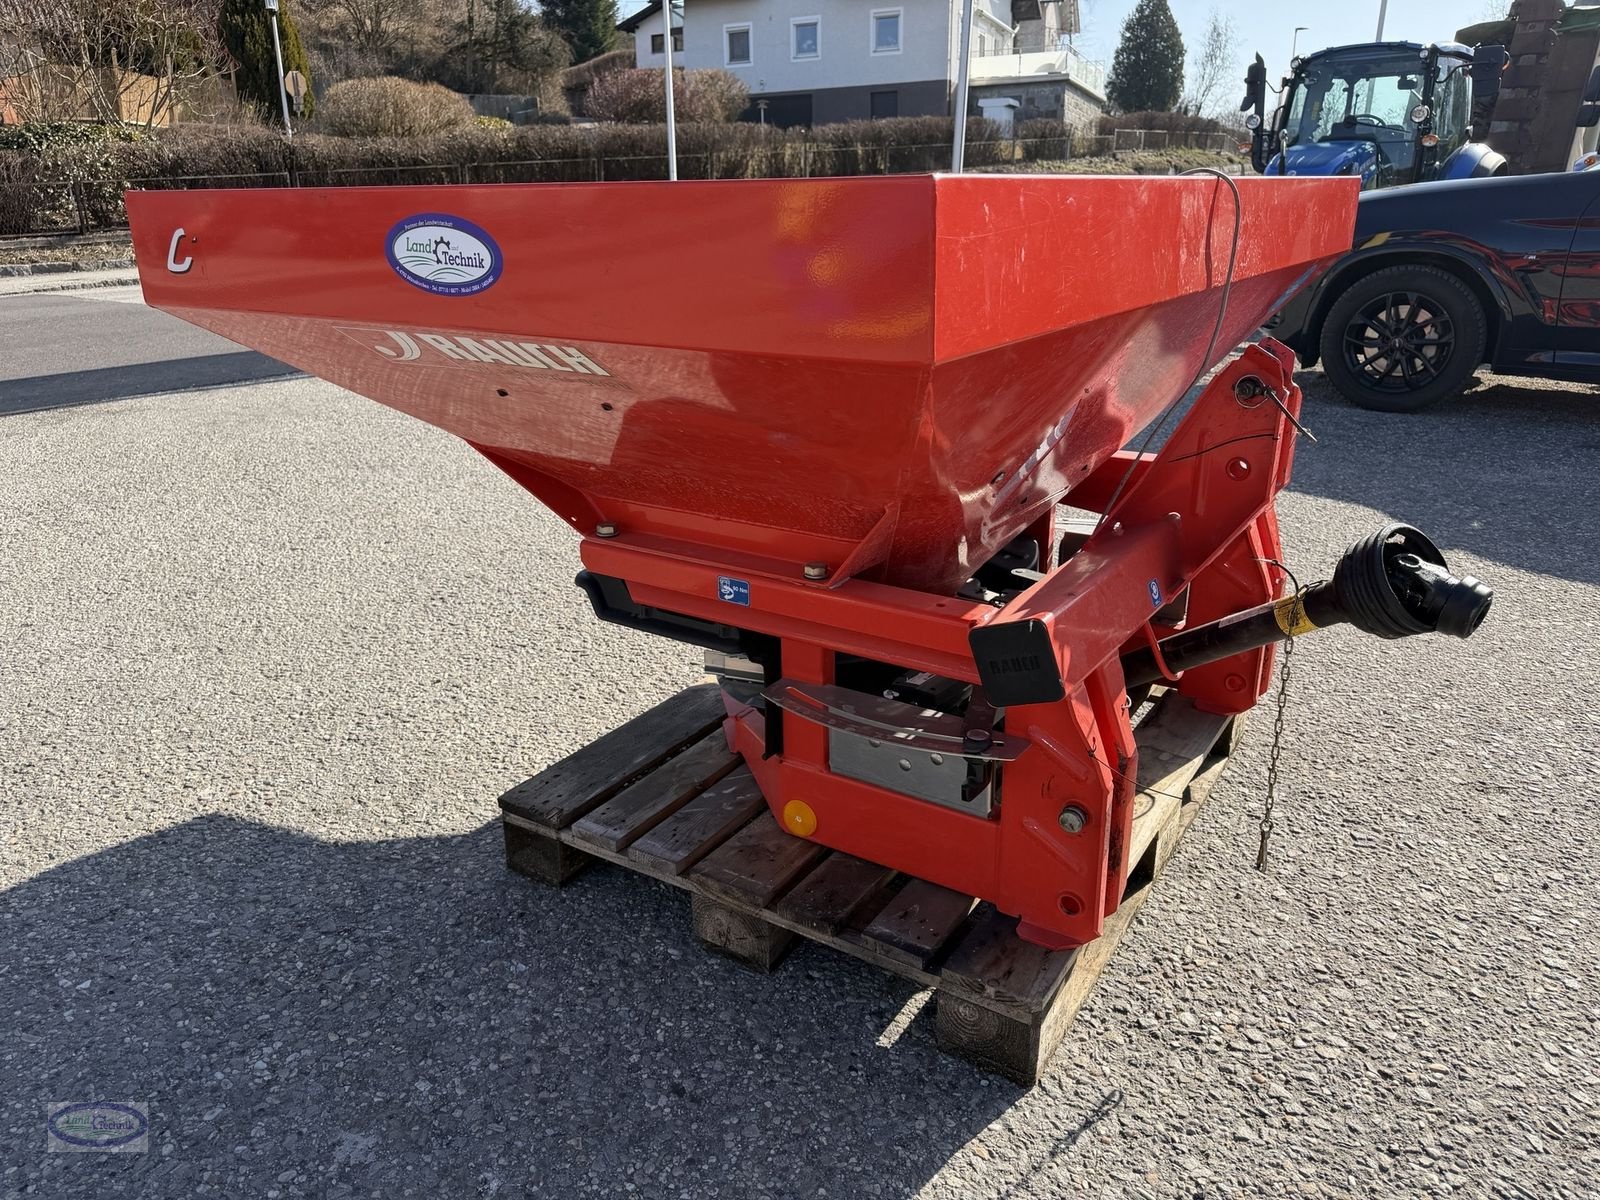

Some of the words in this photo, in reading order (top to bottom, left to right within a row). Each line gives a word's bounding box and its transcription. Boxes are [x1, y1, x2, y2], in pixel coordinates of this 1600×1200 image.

[406, 237, 432, 254] Land
[442, 251, 485, 269] Technik
[415, 333, 612, 377] RAUCH
